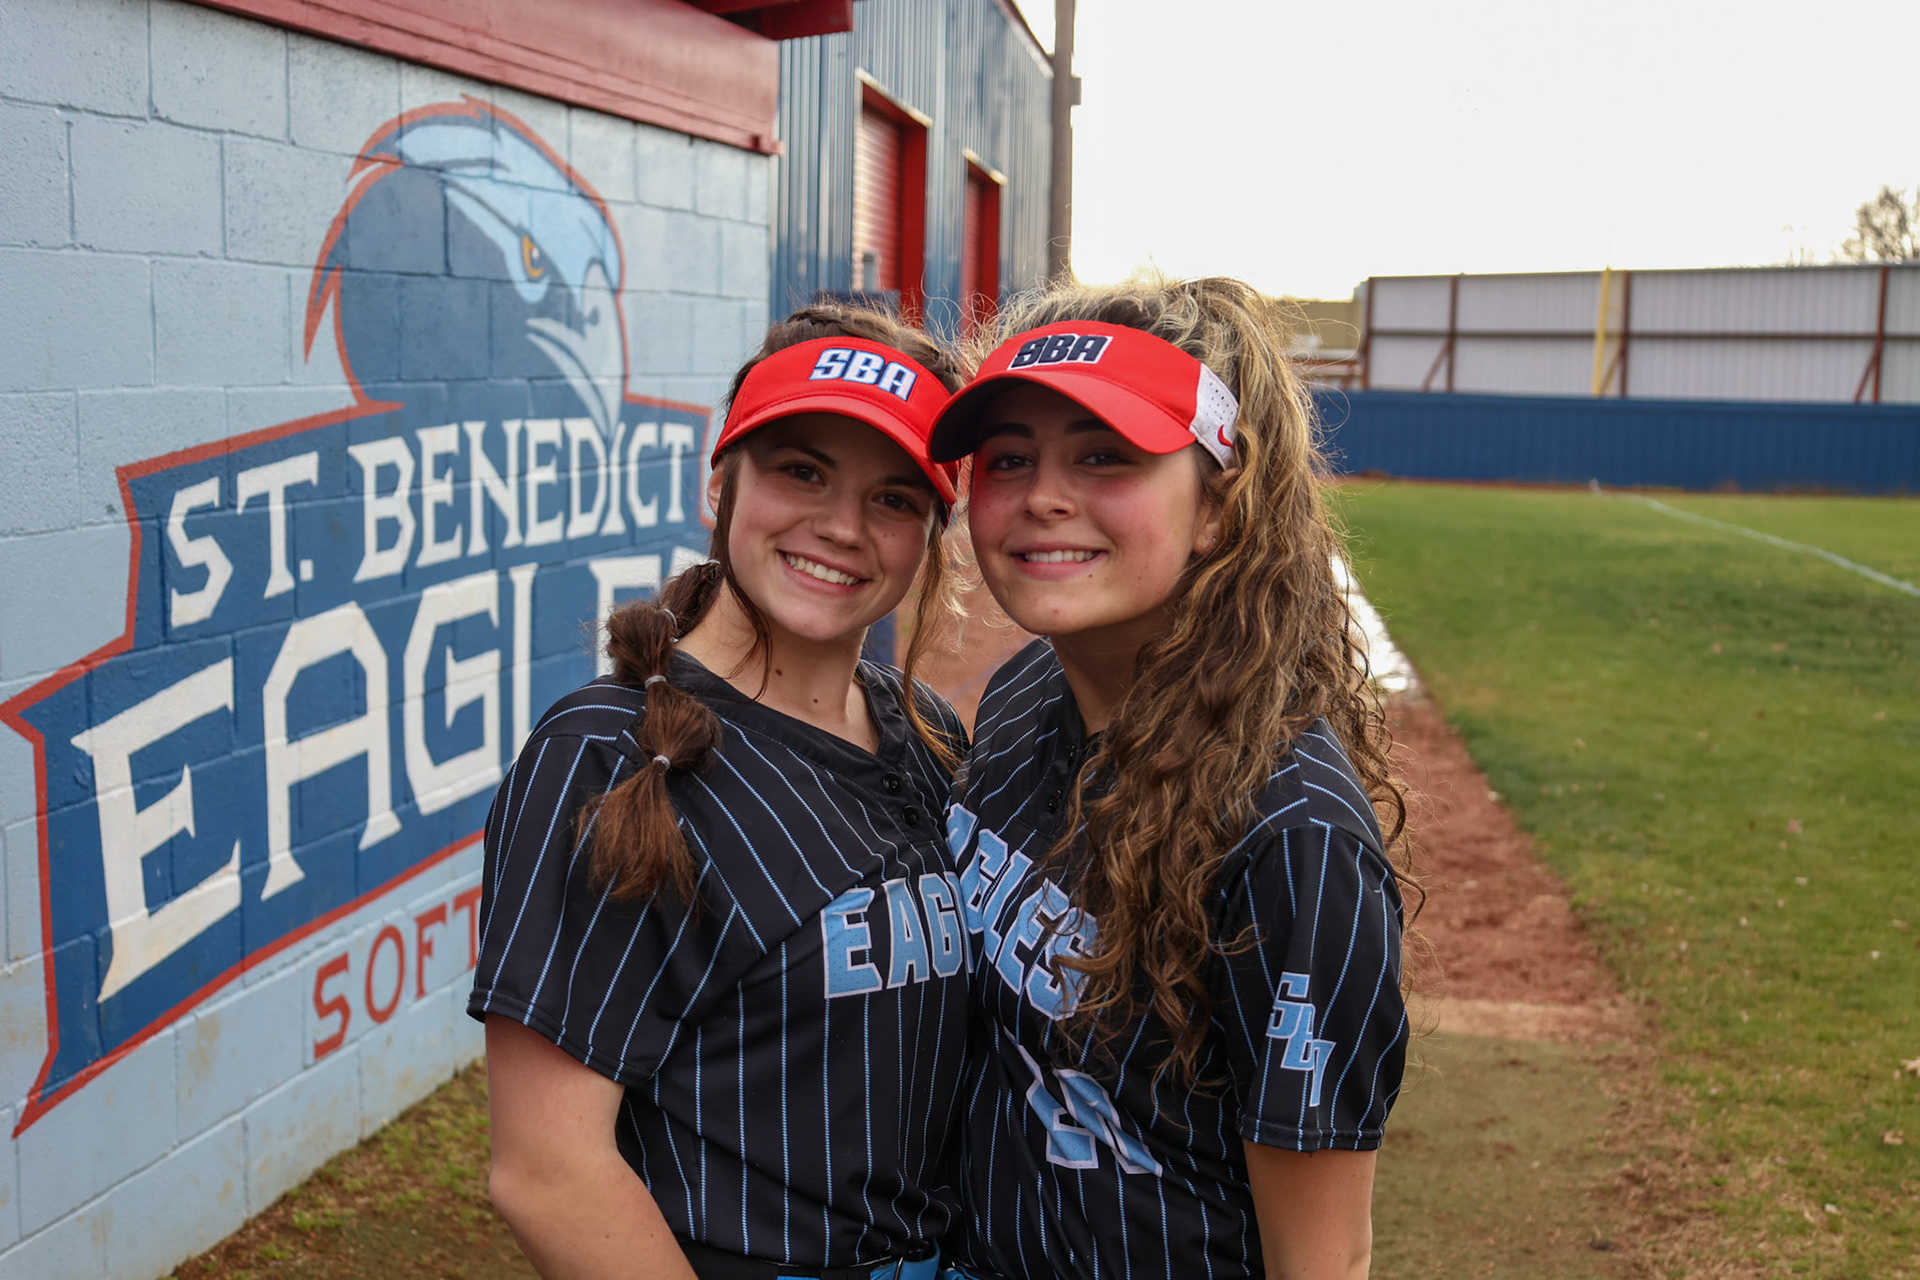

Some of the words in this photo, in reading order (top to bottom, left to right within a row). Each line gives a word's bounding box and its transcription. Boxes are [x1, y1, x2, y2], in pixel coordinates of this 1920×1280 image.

[808, 346, 919, 402] SBA
[1006, 332, 1114, 371] SBA
[166, 450, 319, 628] ST.
[347, 417, 695, 584] BENEDICT
[70, 546, 709, 1004] EAGL
[820, 870, 975, 1000] EAG
